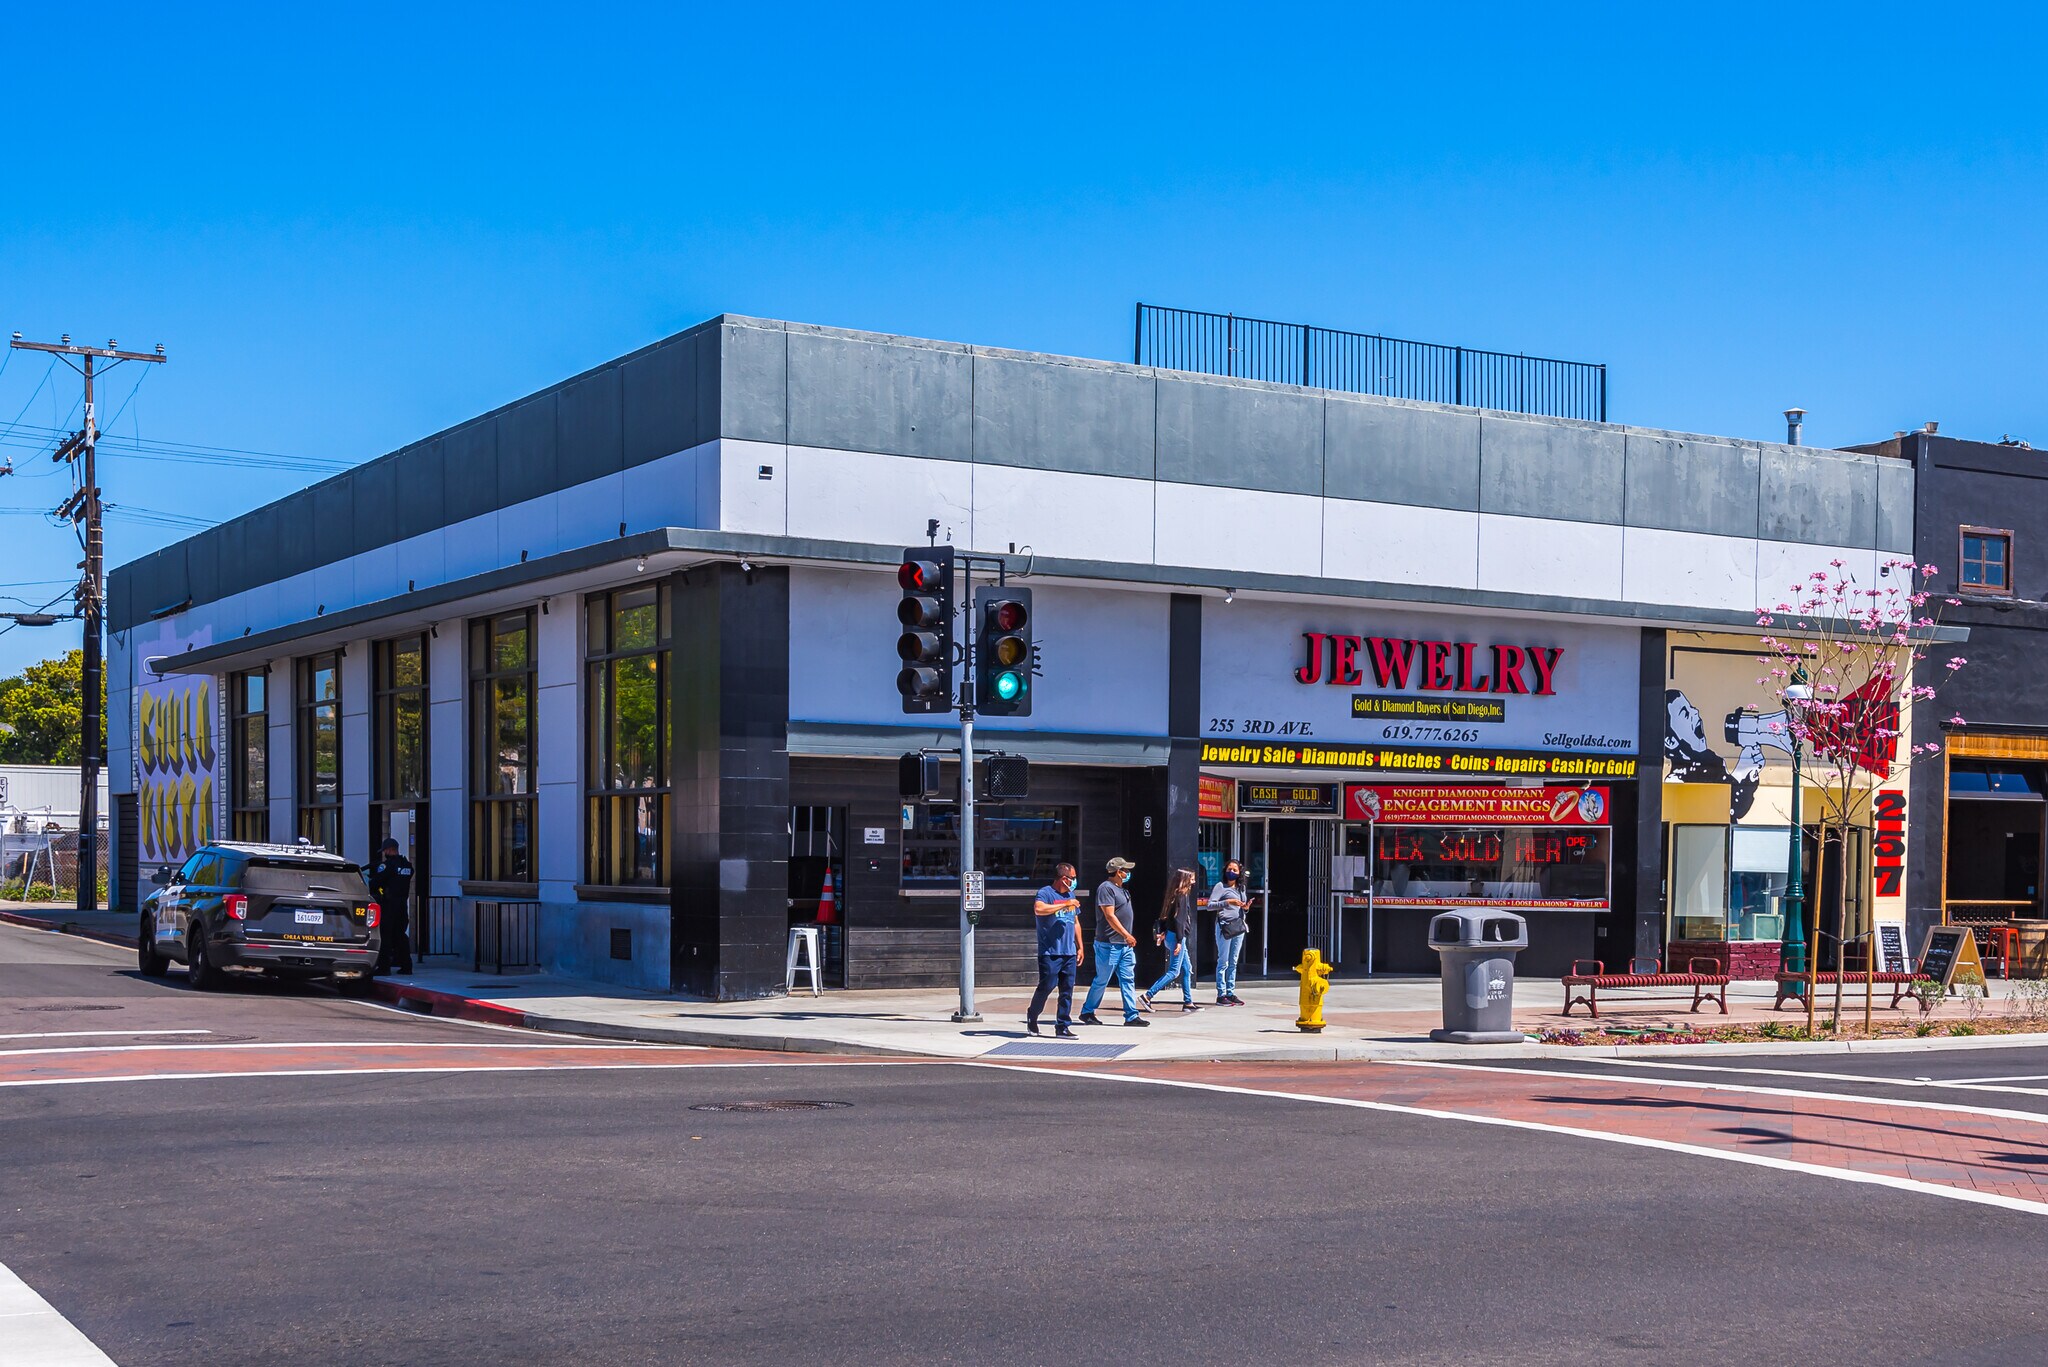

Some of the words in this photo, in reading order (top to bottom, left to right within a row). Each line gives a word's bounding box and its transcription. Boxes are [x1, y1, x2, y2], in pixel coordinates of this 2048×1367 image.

[1294, 633, 1564, 695] JEWELRY
[1355, 699, 1372, 711] Gold
[1374, 699, 1380, 712] &
[1382, 700, 1415, 713] Diamond
[1417, 701, 1441, 716] Buyers
[1443, 702, 1451, 714] of
[1452, 702, 1466, 714] San
[140, 679, 212, 770] CHULA
[1209, 718, 1235, 732] 255
[1242, 720, 1275, 734] 3RD
[1277, 721, 1314, 736] AVE.
[1382, 726, 1479, 742] 619.777.6265
[1543, 732, 1632, 749] Sellgoldsd.com
[1201, 744, 1261, 764] Jewelry
[1263, 746, 1296, 763] Sale
[1301, 748, 1375, 767] Diamonds
[1379, 751, 1441, 769] Watches
[1451, 754, 1490, 771] Coins
[1494, 756, 1547, 773] Repairs
[1551, 757, 1583, 773] Cash
[1585, 758, 1605, 775] For
[1606, 759, 1635, 776] Gold
[1252, 787, 1278, 799] CASH
[1292, 789, 1317, 800] GOLD
[1393, 788, 1436, 798] KNIGHT
[1437, 788, 1489, 798] DIAMOND
[1491, 789, 1545, 798] COMPANY
[141, 771, 213, 852] VISTA
[1383, 799, 1495, 812] ENGAGEMENT
[1500, 799, 1551, 812] RINGS
[1430, 814, 1545, 822] KNIGHTDIAMONDCOMPANY.COM
[1440, 836, 1499, 861] SOLD
[1874, 793, 1906, 894] 257
[355, 908, 366, 916] 52
